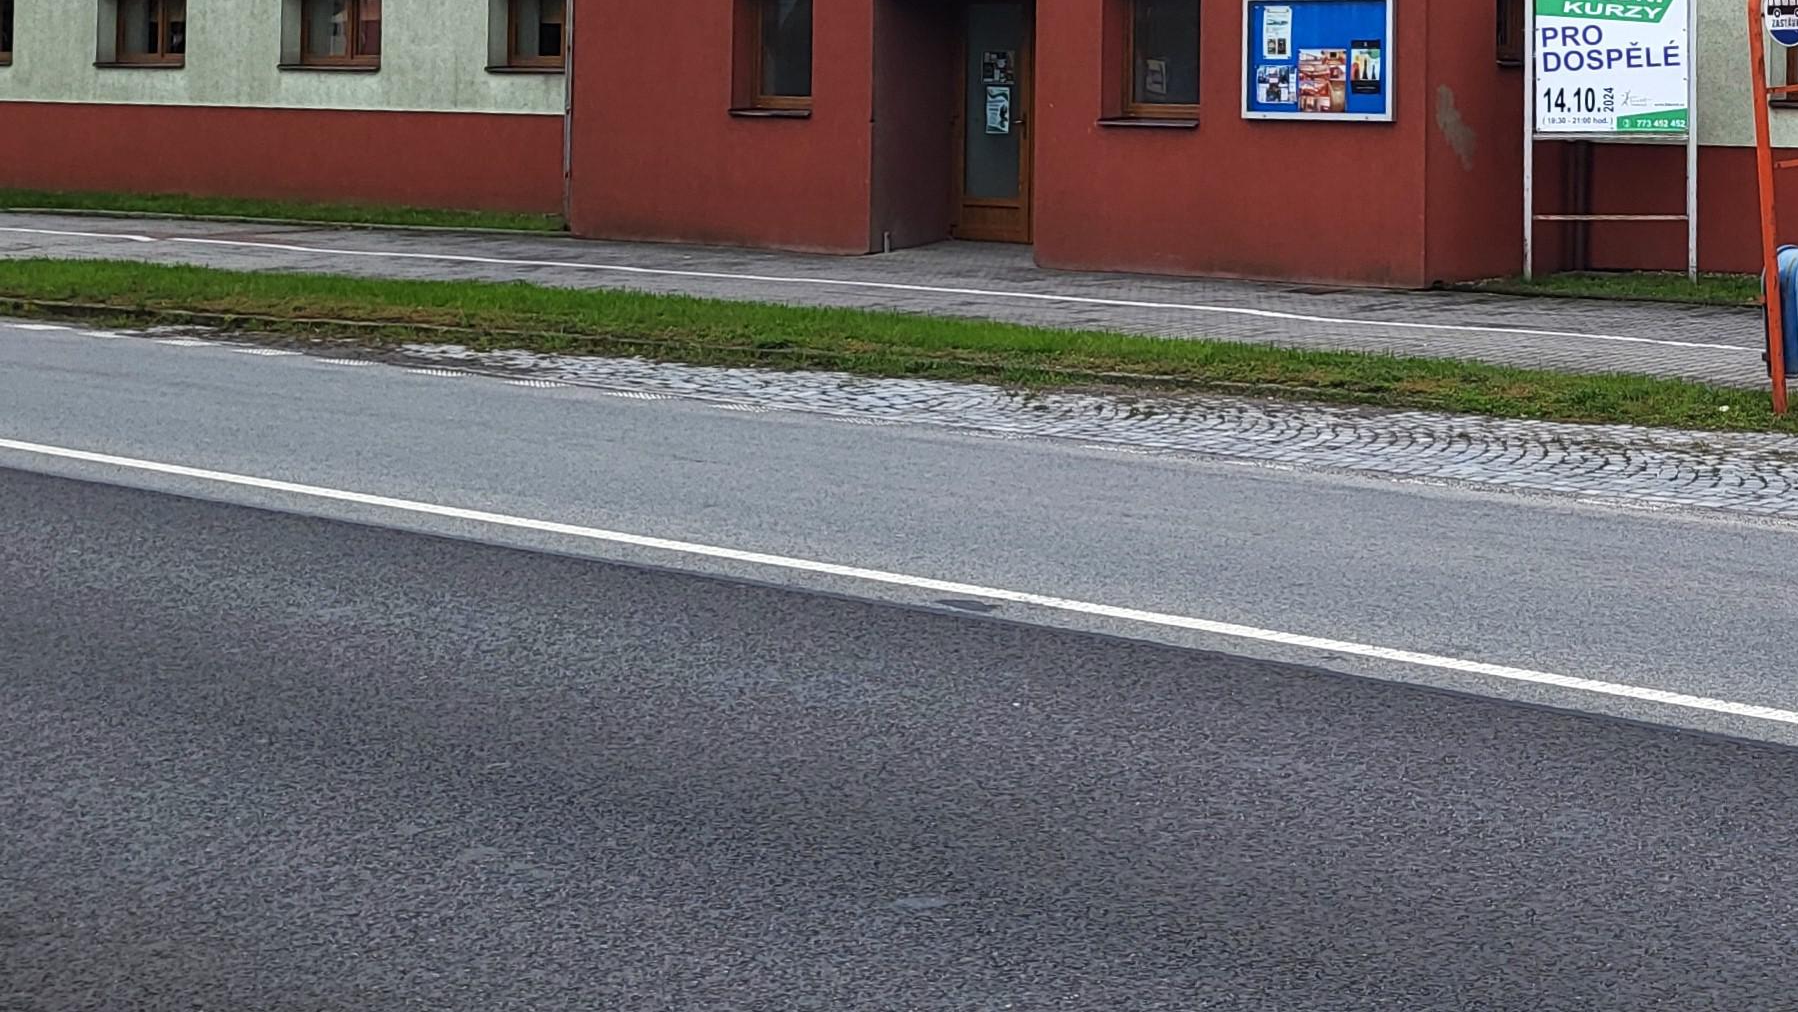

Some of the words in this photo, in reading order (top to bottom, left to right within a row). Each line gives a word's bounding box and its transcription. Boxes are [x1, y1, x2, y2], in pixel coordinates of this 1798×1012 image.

[1563, 1, 1663, 19] KURZY
[1541, 25, 1603, 48] PRO
[1542, 40, 1681, 73] DOSPĚLÉ
[1543, 87, 1601, 113] 14.10.
[1603, 87, 1615, 113] 2024
[1636, 119, 1652, 128] 773
